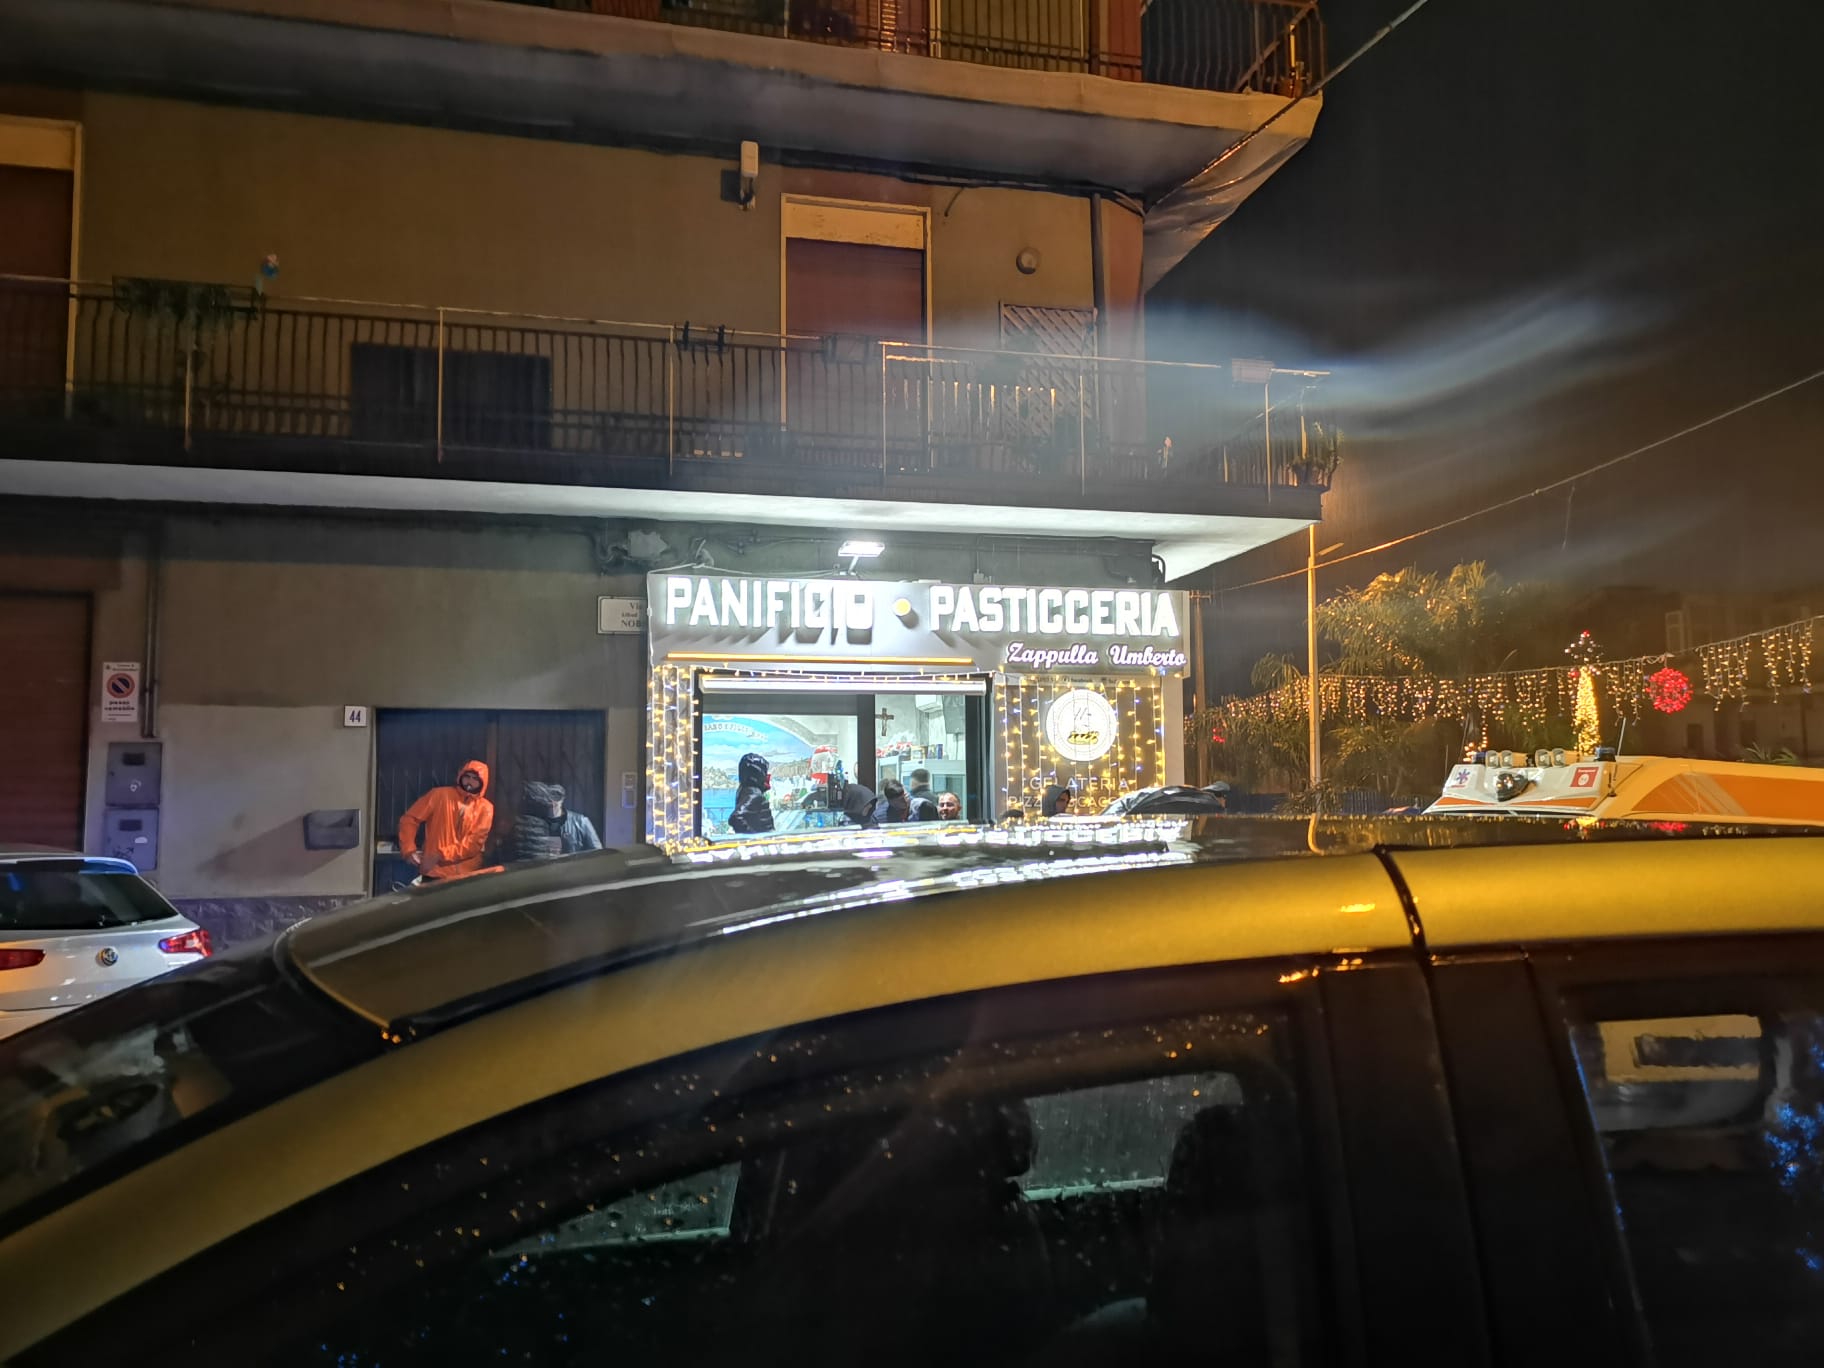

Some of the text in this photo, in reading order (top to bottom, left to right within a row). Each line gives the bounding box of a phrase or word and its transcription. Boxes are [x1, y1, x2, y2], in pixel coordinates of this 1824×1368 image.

[666, 576, 1179, 637] PANIFICIO PASTICCERIA
[1007, 642, 1187, 669] Zappulla Umberto
[349, 709, 361, 723] 44
